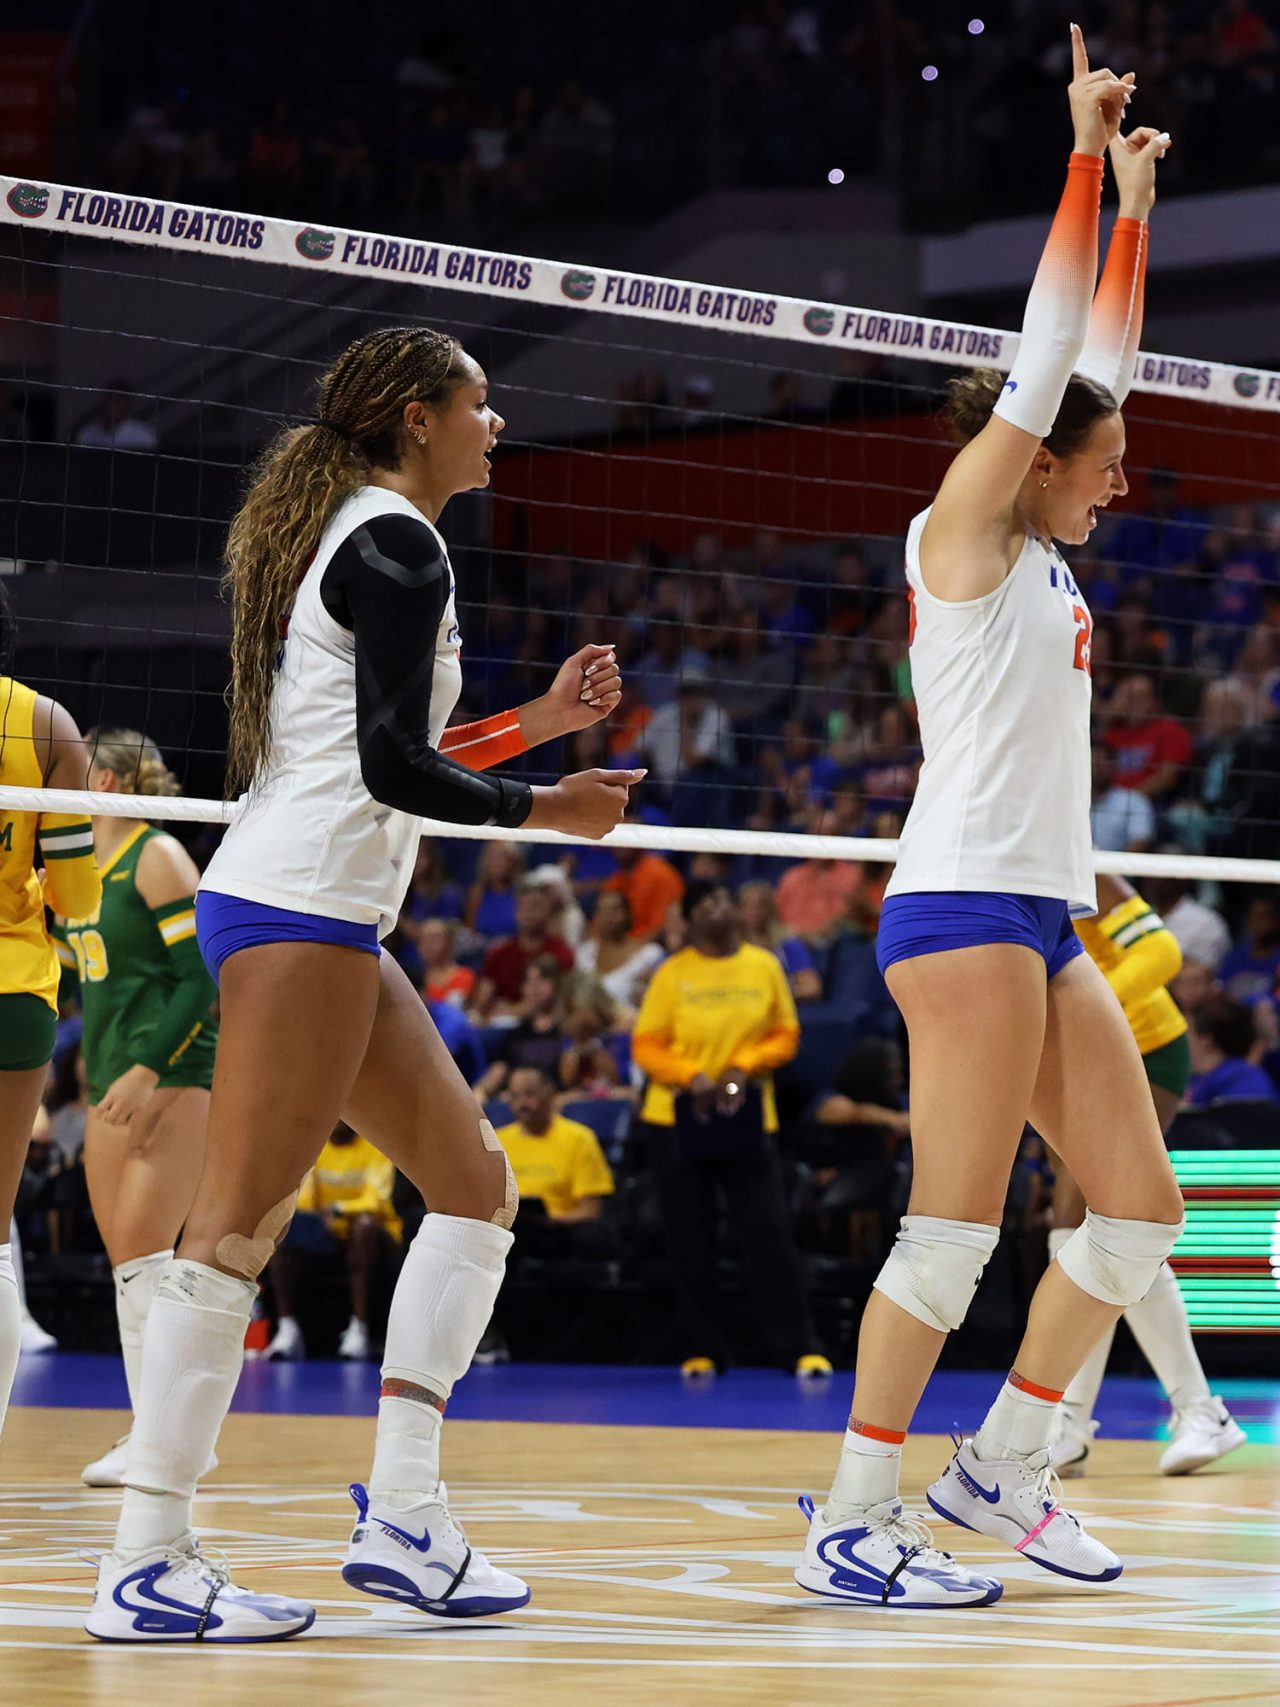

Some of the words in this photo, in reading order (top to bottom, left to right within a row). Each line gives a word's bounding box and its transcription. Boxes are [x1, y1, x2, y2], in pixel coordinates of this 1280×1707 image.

[56, 190, 162, 235] FLORIDA
[168, 210, 265, 250] GATORS
[341, 235, 439, 277] FLORIDA
[444, 256, 532, 290] GATORS
[602, 276, 692, 315] FLORIDA
[696, 292, 776, 326] GATORS
[841, 313, 924, 348] FLORIDA
[929, 327, 1001, 358] GATORS
[1142, 358, 1211, 390] GATORS
[66, 929, 109, 983] 19
[955, 1471, 980, 1500] FLORIDA
[380, 1526, 412, 1551] FLORIDA
